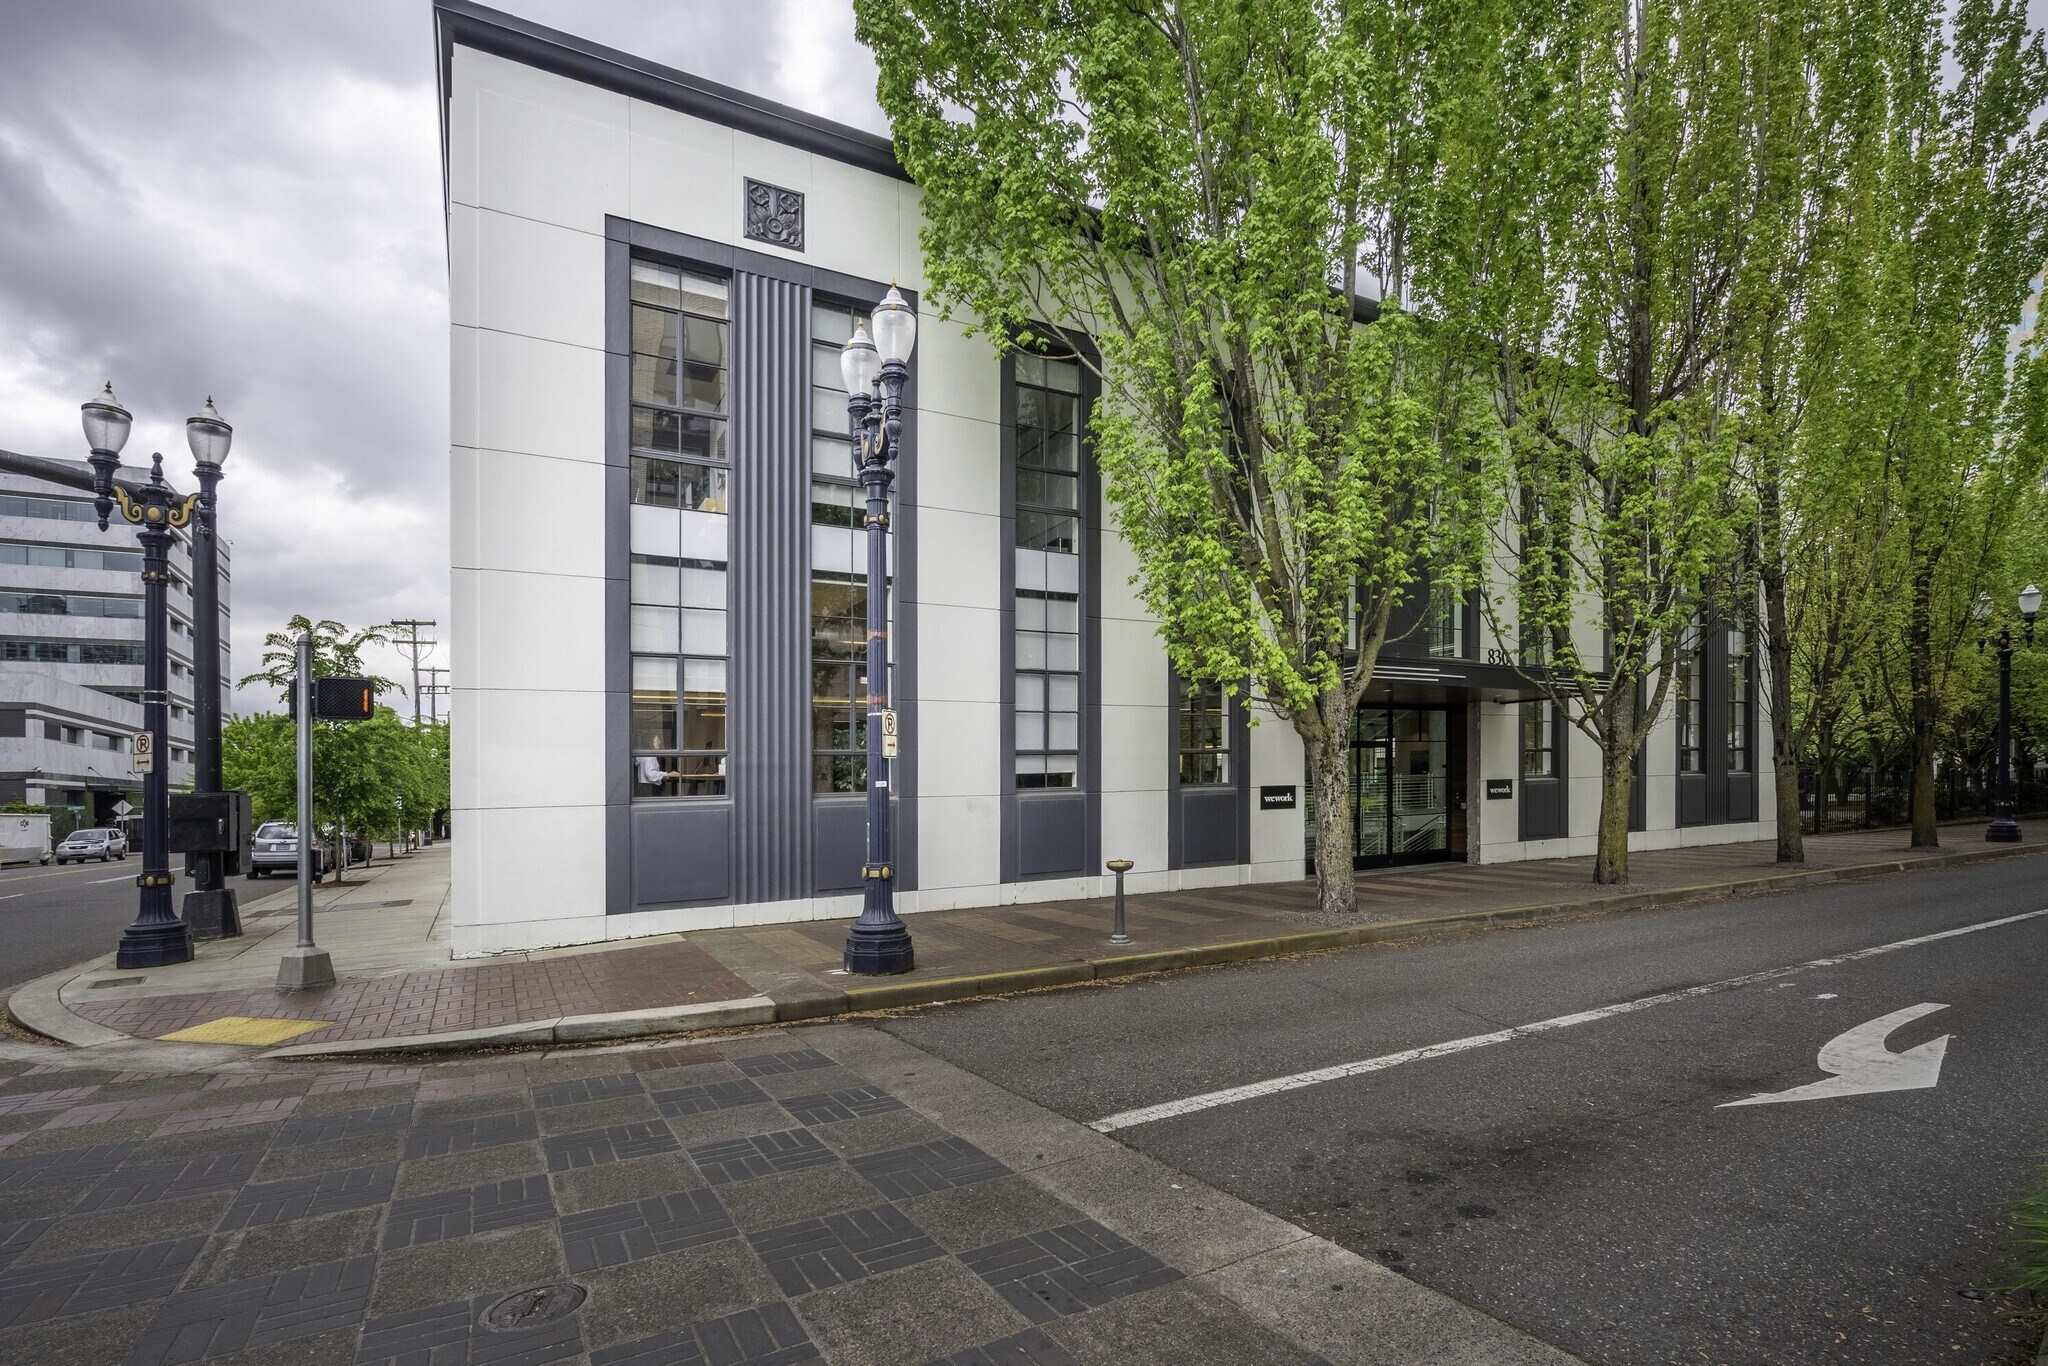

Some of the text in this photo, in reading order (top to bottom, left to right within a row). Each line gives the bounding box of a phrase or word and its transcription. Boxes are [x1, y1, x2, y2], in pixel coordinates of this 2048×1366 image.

[1488, 648, 1509, 665] 830
[1489, 785, 1511, 794] wework
[1264, 792, 1293, 803] wework
